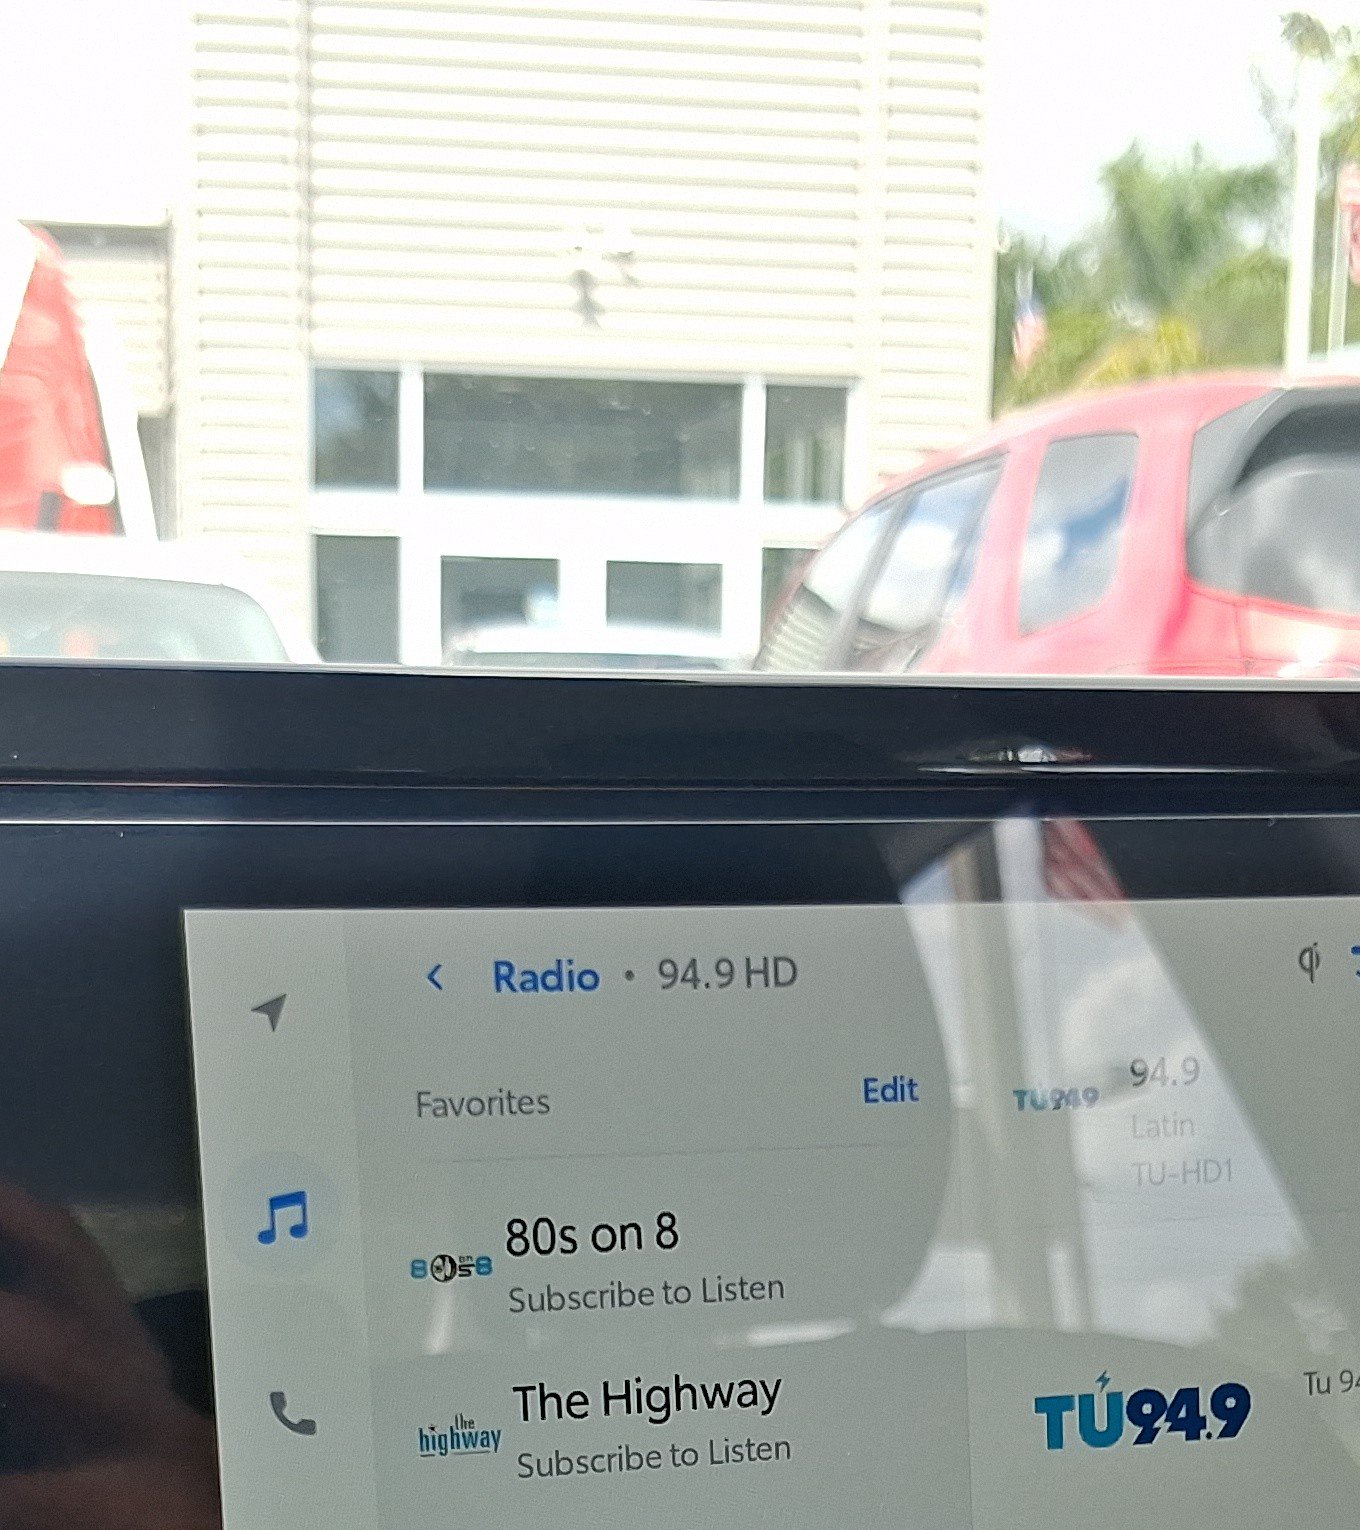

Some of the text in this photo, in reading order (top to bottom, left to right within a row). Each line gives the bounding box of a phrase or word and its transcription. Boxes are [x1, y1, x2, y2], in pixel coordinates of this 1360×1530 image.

[494, 959, 600, 993] Radio
[658, 956, 798, 990] 94.9 HD
[1130, 1056, 1200, 1088] 94.9
[416, 1088, 551, 1118] Favorites
[863, 1075, 919, 1103] Edit
[1131, 1110, 1195, 1139] Latin
[1131, 1158, 1231, 1187] TU-HD1
[505, 1211, 679, 1258] 80s on 8
[509, 1275, 785, 1313] Subscribe to Listen
[512, 1374, 782, 1425] The Highway
[1303, 1371, 1332, 1396] Tu
[418, 1424, 502, 1457] highway
[518, 1438, 792, 1478] Subscribe to Listen
